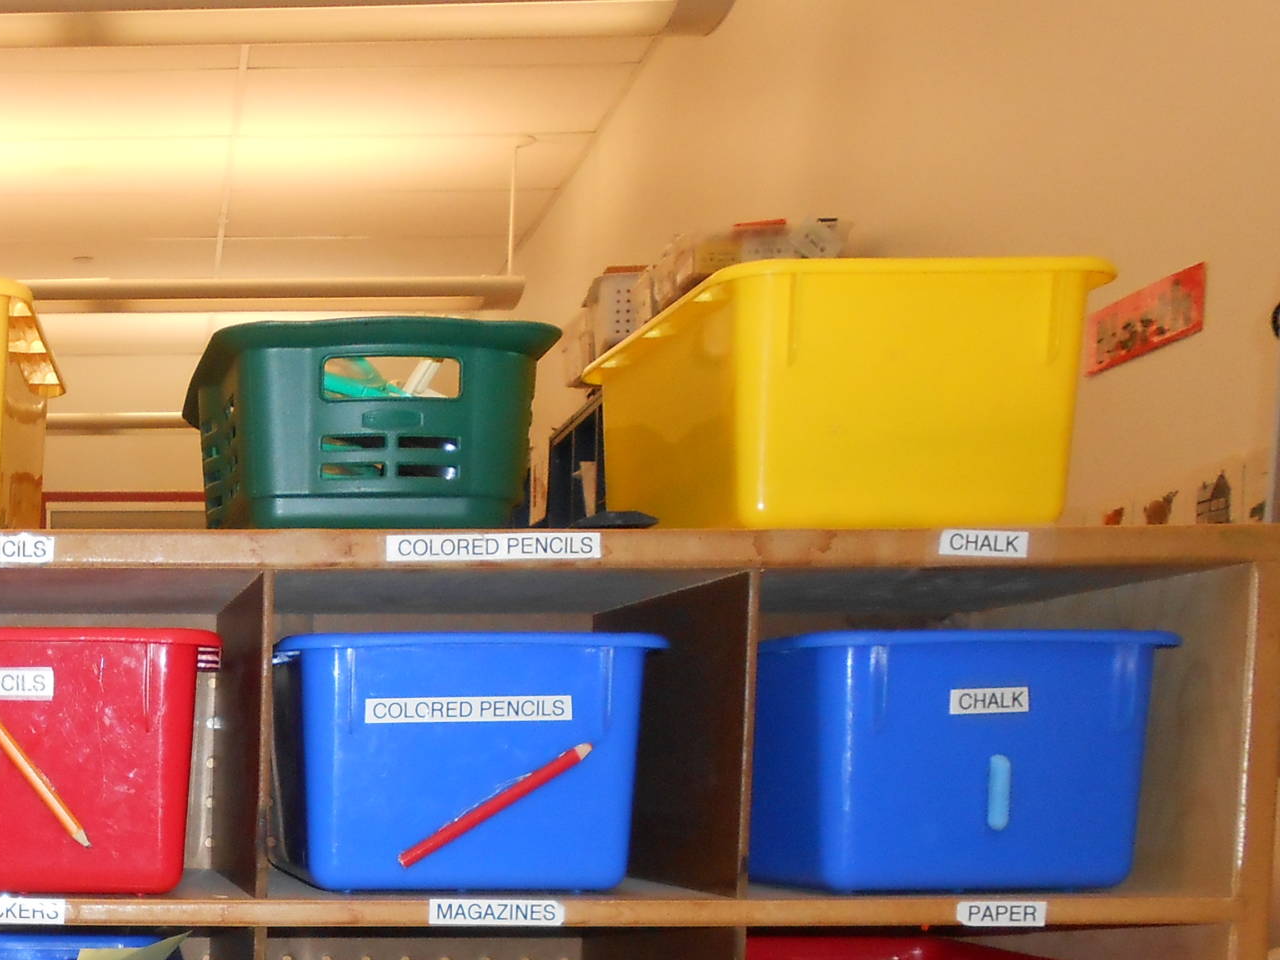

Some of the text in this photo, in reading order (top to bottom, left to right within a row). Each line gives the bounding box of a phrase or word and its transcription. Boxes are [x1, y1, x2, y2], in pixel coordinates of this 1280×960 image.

[398, 537, 593, 556] COLORED PENCILS
[949, 533, 1019, 552] CHALK
[373, 700, 565, 718] COLORED PENCILS
[959, 691, 1024, 709] CHALK
[437, 904, 556, 921] MAGAZINES
[968, 906, 1037, 922] PAPER
